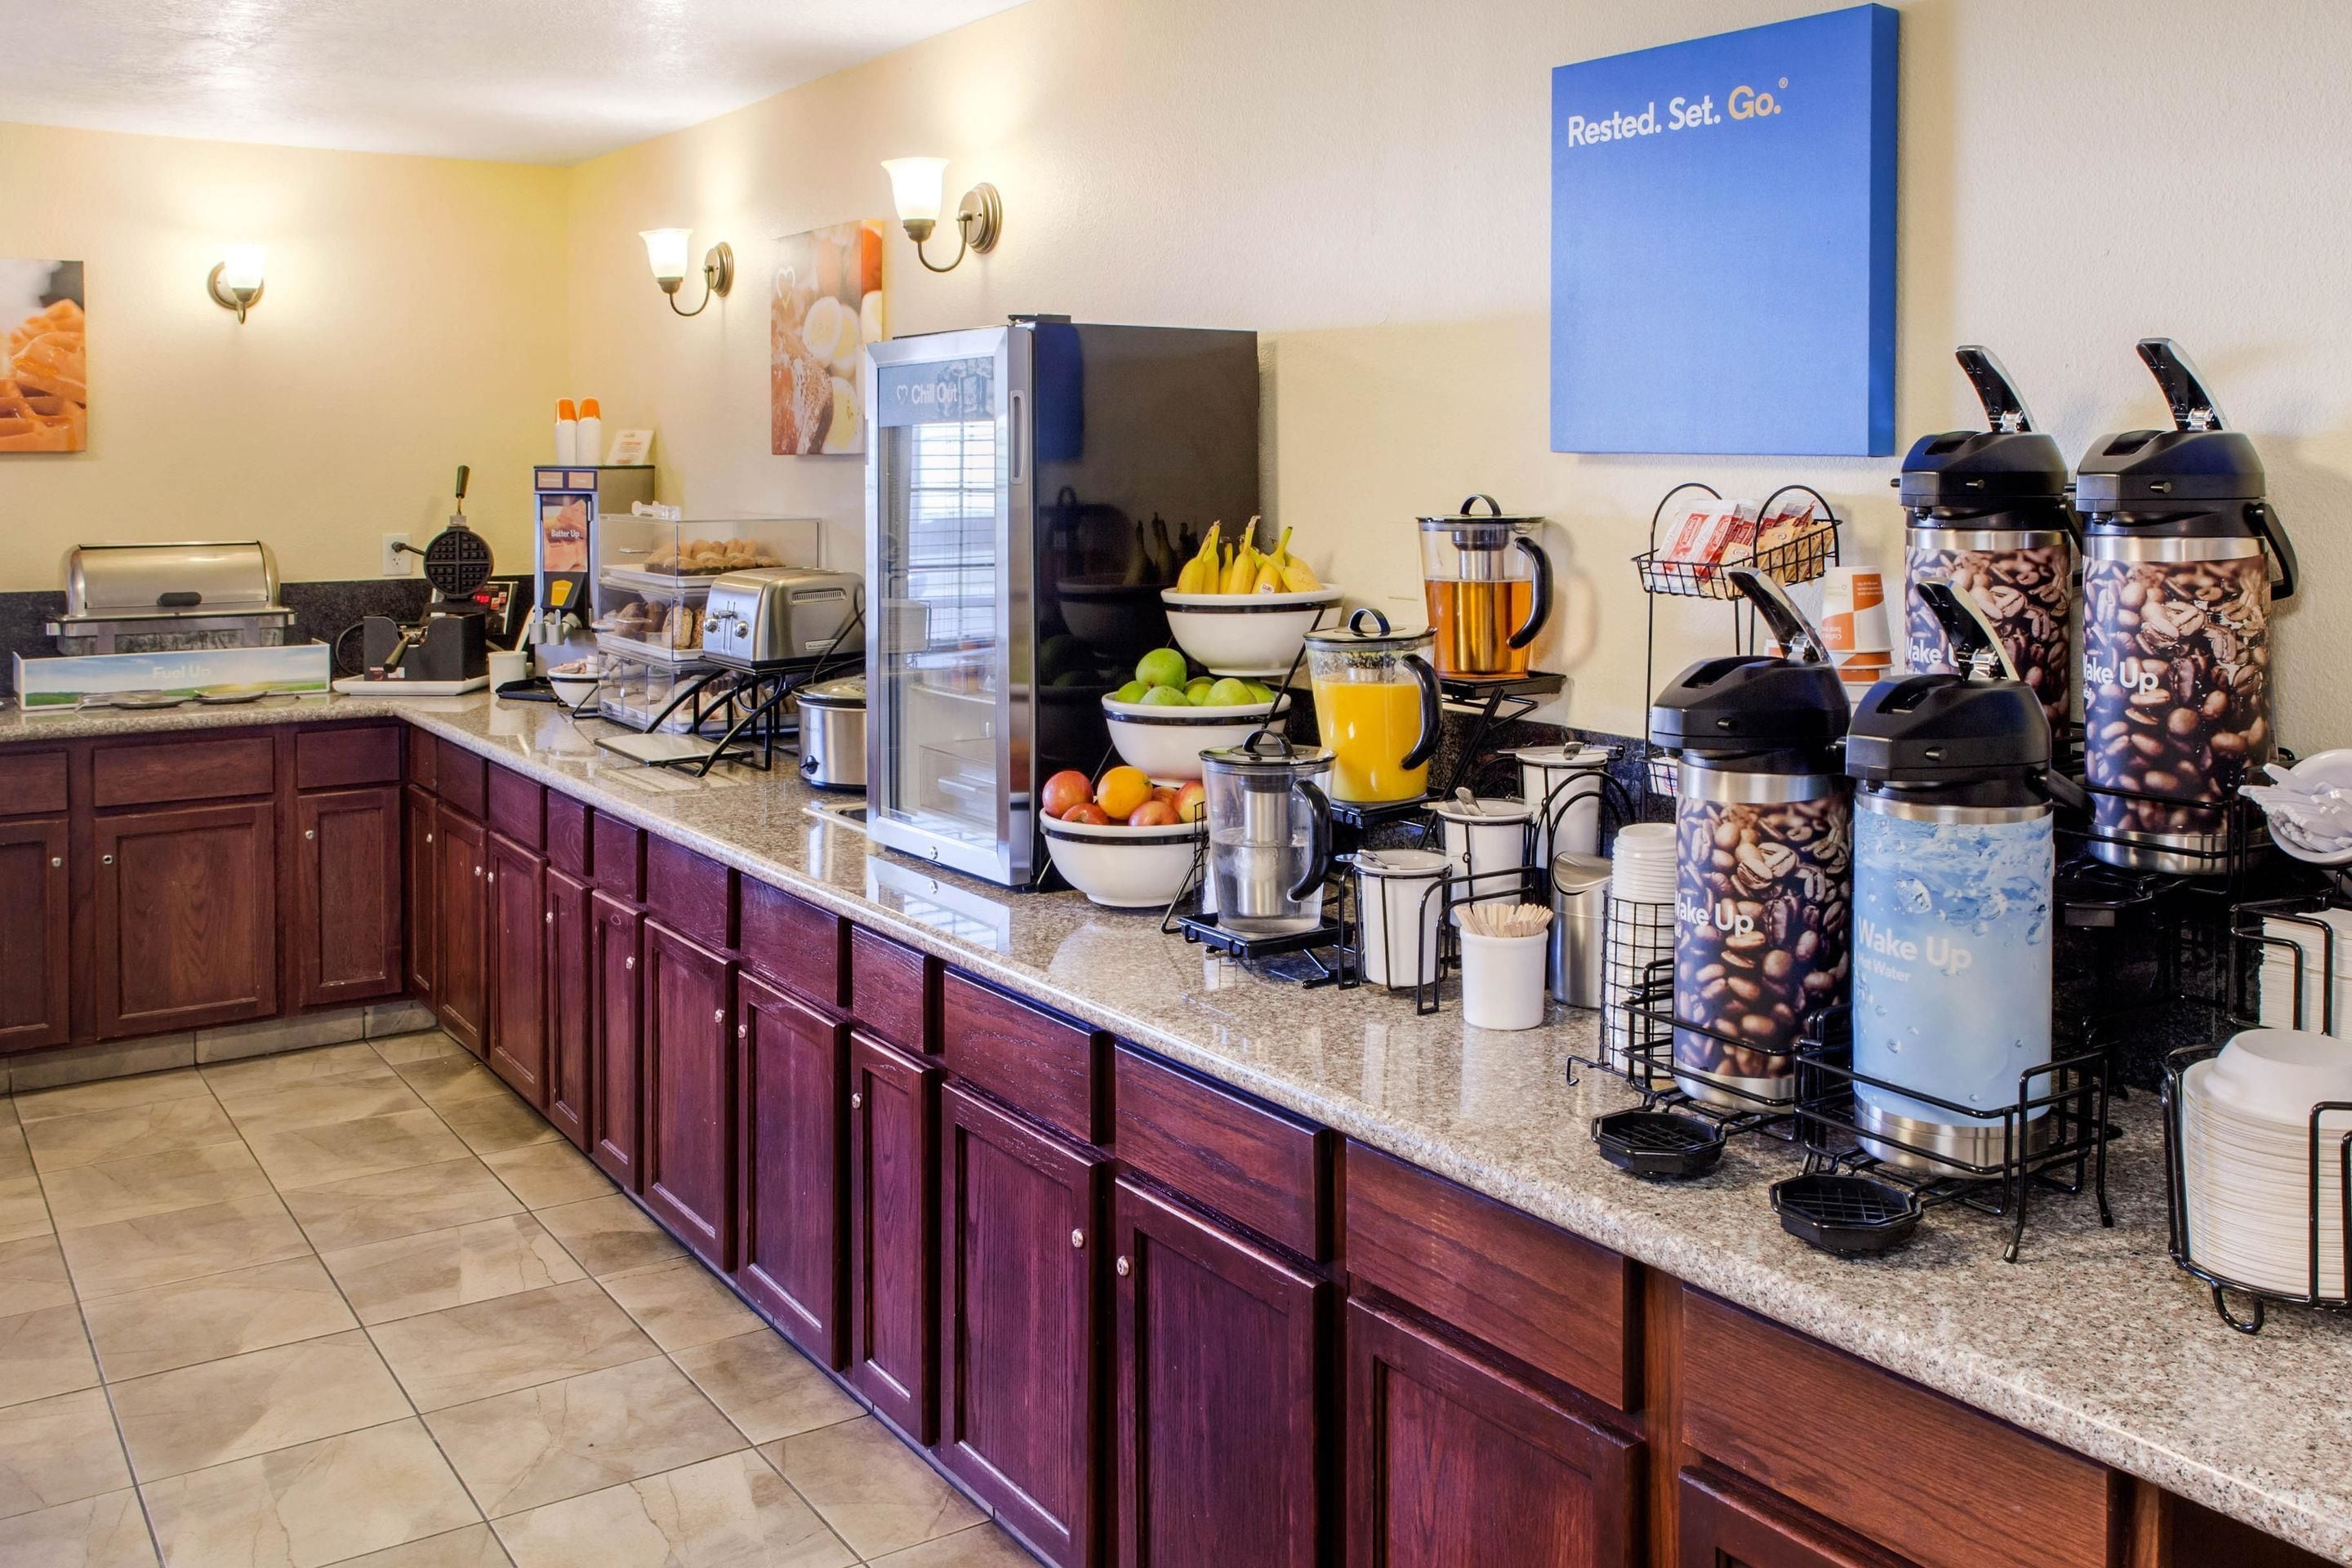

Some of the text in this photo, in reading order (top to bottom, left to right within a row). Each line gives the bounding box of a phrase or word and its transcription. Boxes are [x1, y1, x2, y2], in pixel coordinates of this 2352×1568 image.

[1568, 102, 1662, 147] Rested.
[1668, 96, 1721, 130] Set.
[911, 382, 957, 405] Chill Out
[570, 529, 580, 539] Up
[153, 664, 211, 683] Fuel Up
[2119, 662, 2158, 694] Up
[1715, 903, 1753, 938] Up
[1858, 915, 1973, 975] Wake Up
[1873, 959, 1911, 982] Water
